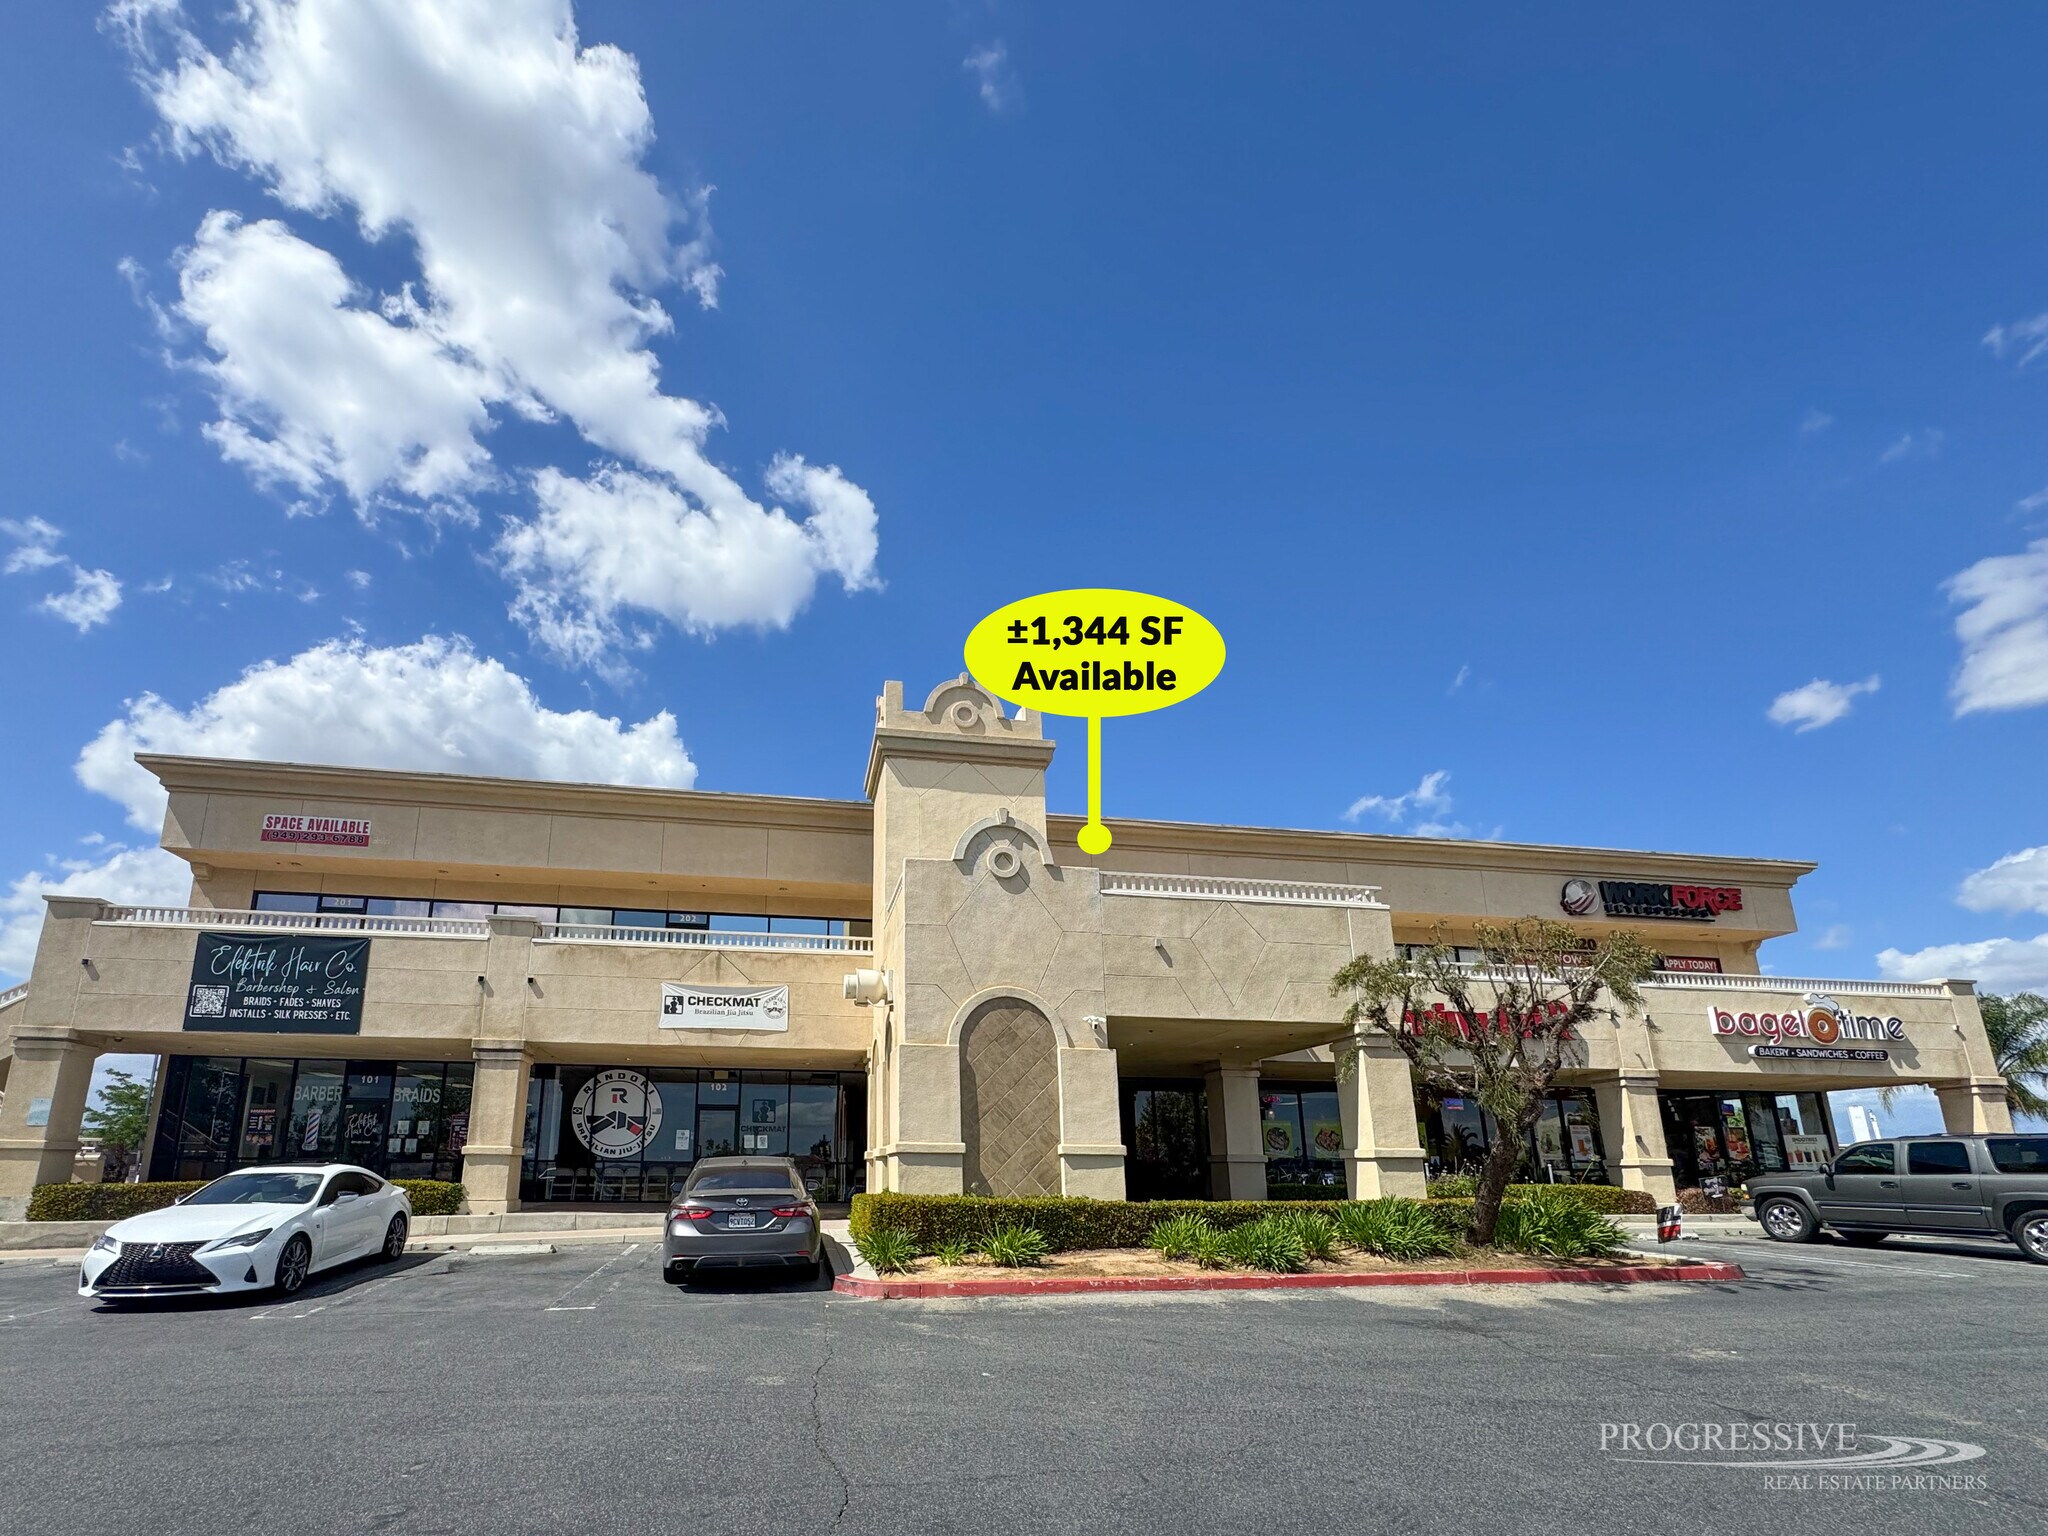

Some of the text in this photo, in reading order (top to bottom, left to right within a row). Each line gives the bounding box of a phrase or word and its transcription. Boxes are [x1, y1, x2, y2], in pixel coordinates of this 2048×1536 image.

[265, 815, 370, 834] SPACE AVAILABLE
[334, 898, 352, 906] 201
[679, 914, 697, 923] 202
[281, 946, 322, 979] Hair
[1664, 959, 1717, 970] APPLY TODAY!
[235, 977, 300, 997] Barbershop
[323, 980, 360, 995] Salon
[243, 997, 342, 1008] BRAIDS FADES SHAVES
[687, 995, 762, 1008] CHECKMAT
[229, 1008, 266, 1019] INSTALLS
[274, 1009, 292, 1019] SILK
[293, 1010, 328, 1020] PRESSES
[726, 1008, 737, 1017] Jiu
[737, 1009, 754, 1017] Jitsu
[1712, 1005, 1906, 1046] bagel time
[1758, 1047, 1885, 1060] BAKERY SANDWICHES COFFEE
[361, 1075, 379, 1084] 101
[294, 1085, 343, 1101] BARBER
[710, 1083, 727, 1091] 102
[393, 1087, 441, 1104] BRAIDS
